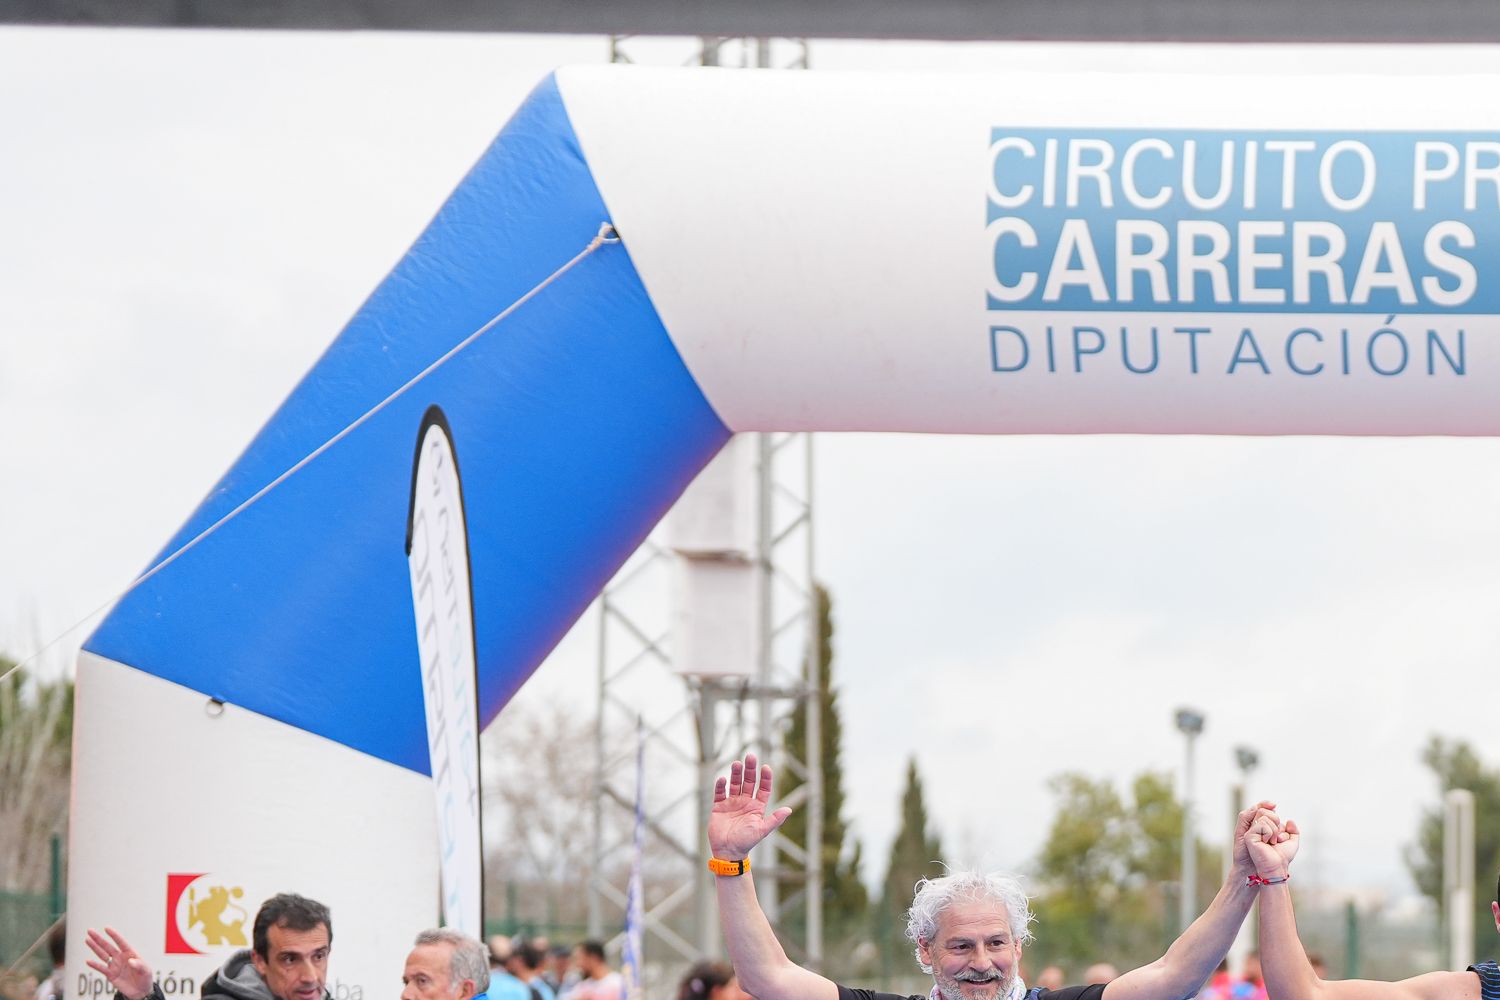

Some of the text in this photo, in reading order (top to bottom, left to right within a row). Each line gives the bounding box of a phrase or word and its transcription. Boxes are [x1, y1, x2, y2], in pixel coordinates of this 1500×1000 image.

[986, 136, 1377, 212] CIRCUITO
[986, 217, 1478, 306] CARRERAS
[988, 314, 1467, 377] DIPUTACIÓN
[78, 971, 195, 1000] Dipuión
